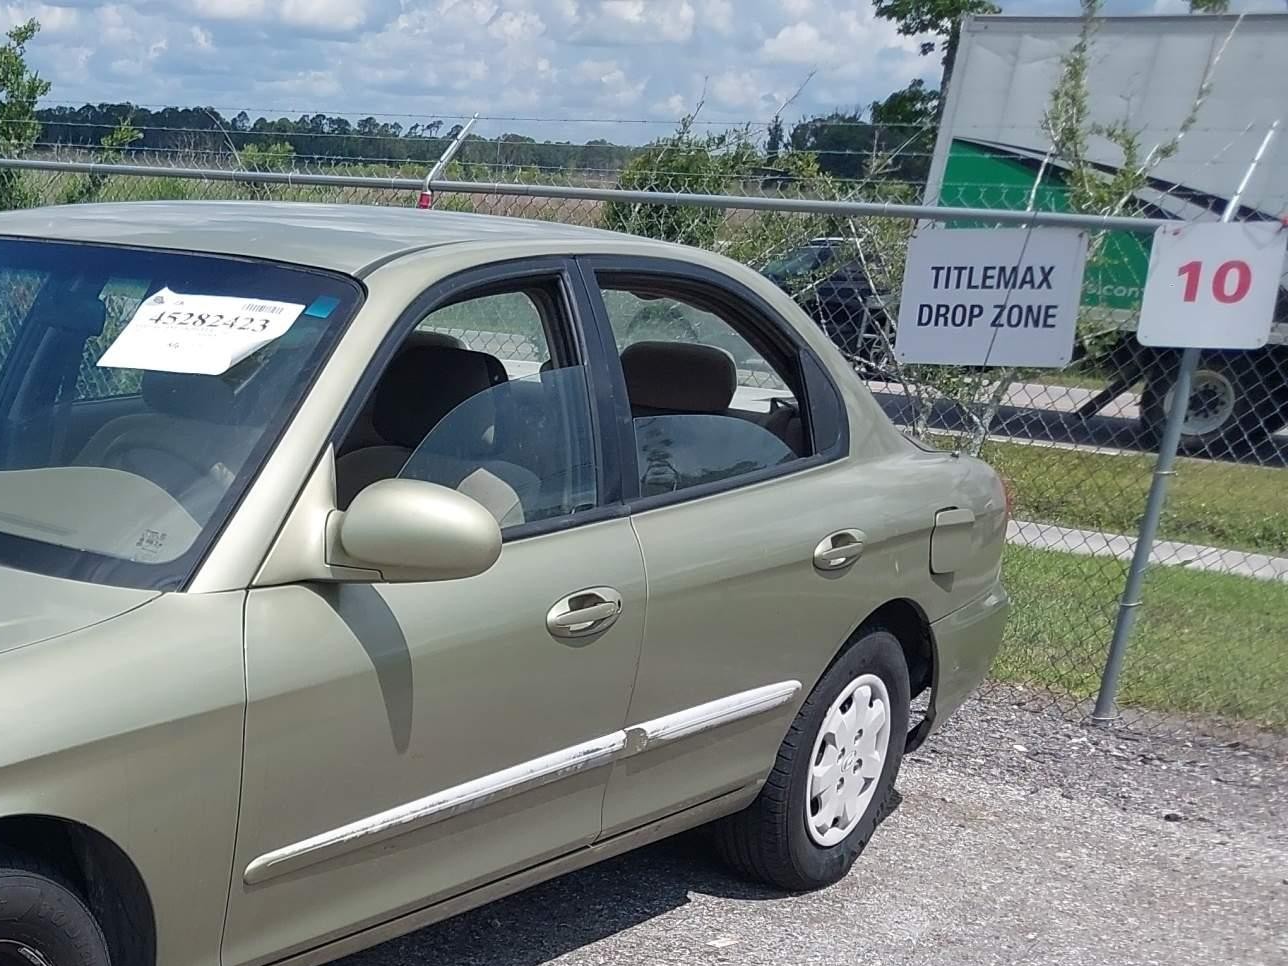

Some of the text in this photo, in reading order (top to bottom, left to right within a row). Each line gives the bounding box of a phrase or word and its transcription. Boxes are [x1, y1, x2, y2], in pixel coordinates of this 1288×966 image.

[930, 265, 1056, 290] TITLEMAX
[1177, 260, 1252, 304] 10
[148, 311, 271, 333] 45282423
[916, 303, 1059, 329] DROP ZONE
